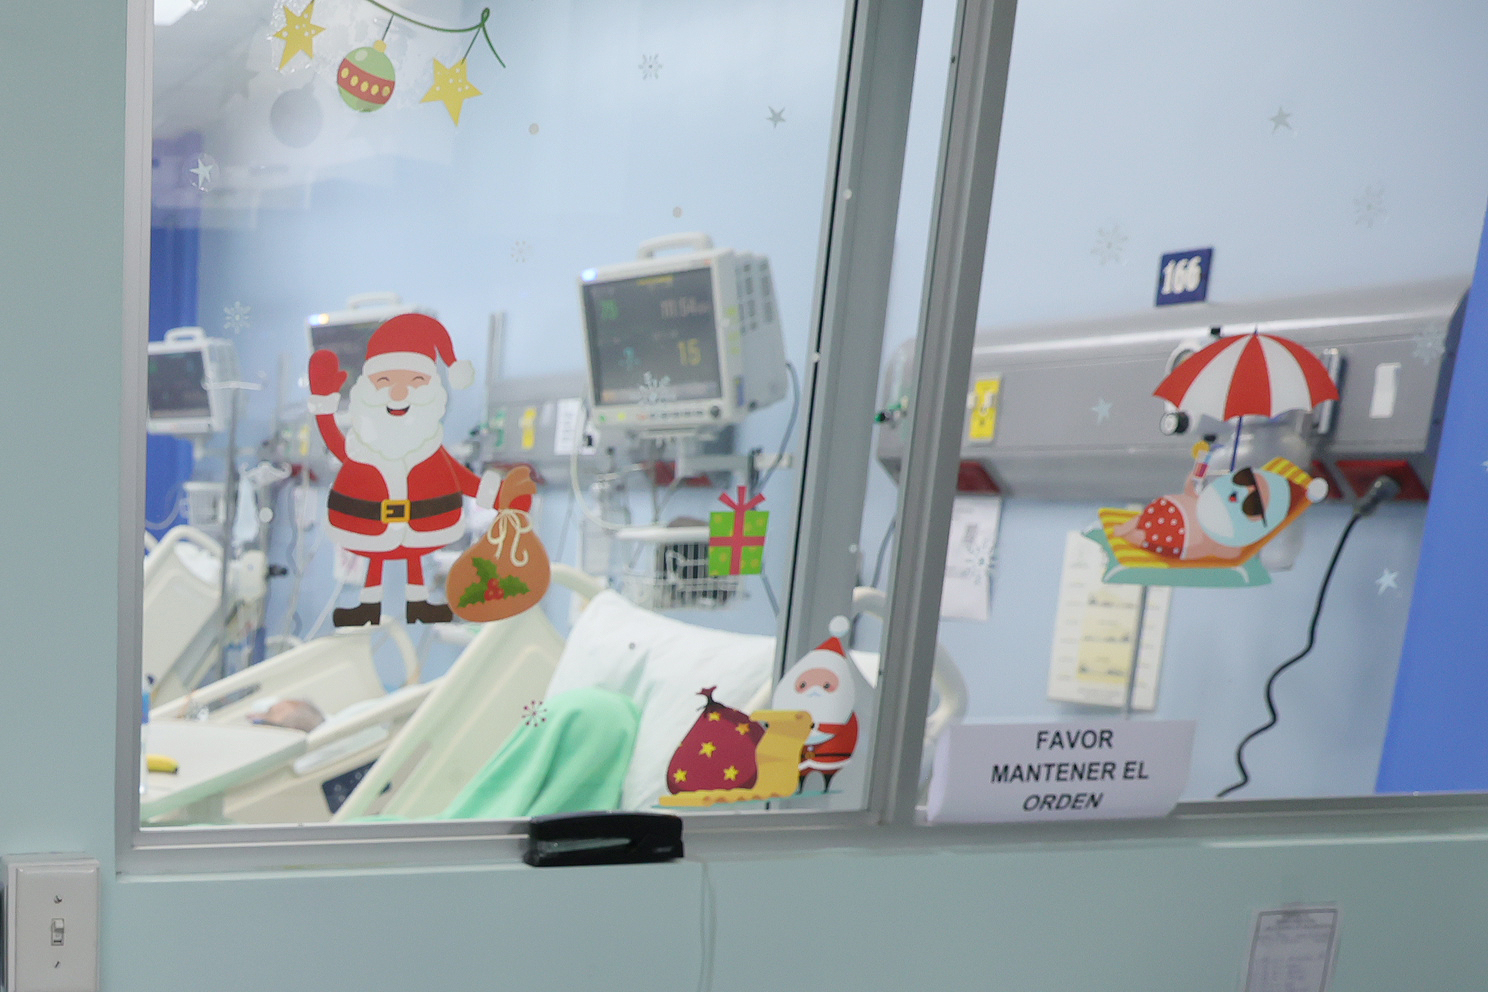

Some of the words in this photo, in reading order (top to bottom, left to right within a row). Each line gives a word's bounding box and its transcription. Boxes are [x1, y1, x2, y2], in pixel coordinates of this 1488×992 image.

[1162, 256, 1201, 295] 166
[1036, 729, 1114, 750] FAVOR
[990, 761, 1116, 784] MANTENER
[1122, 761, 1149, 780] EL
[1022, 792, 1104, 812] ORDEN
